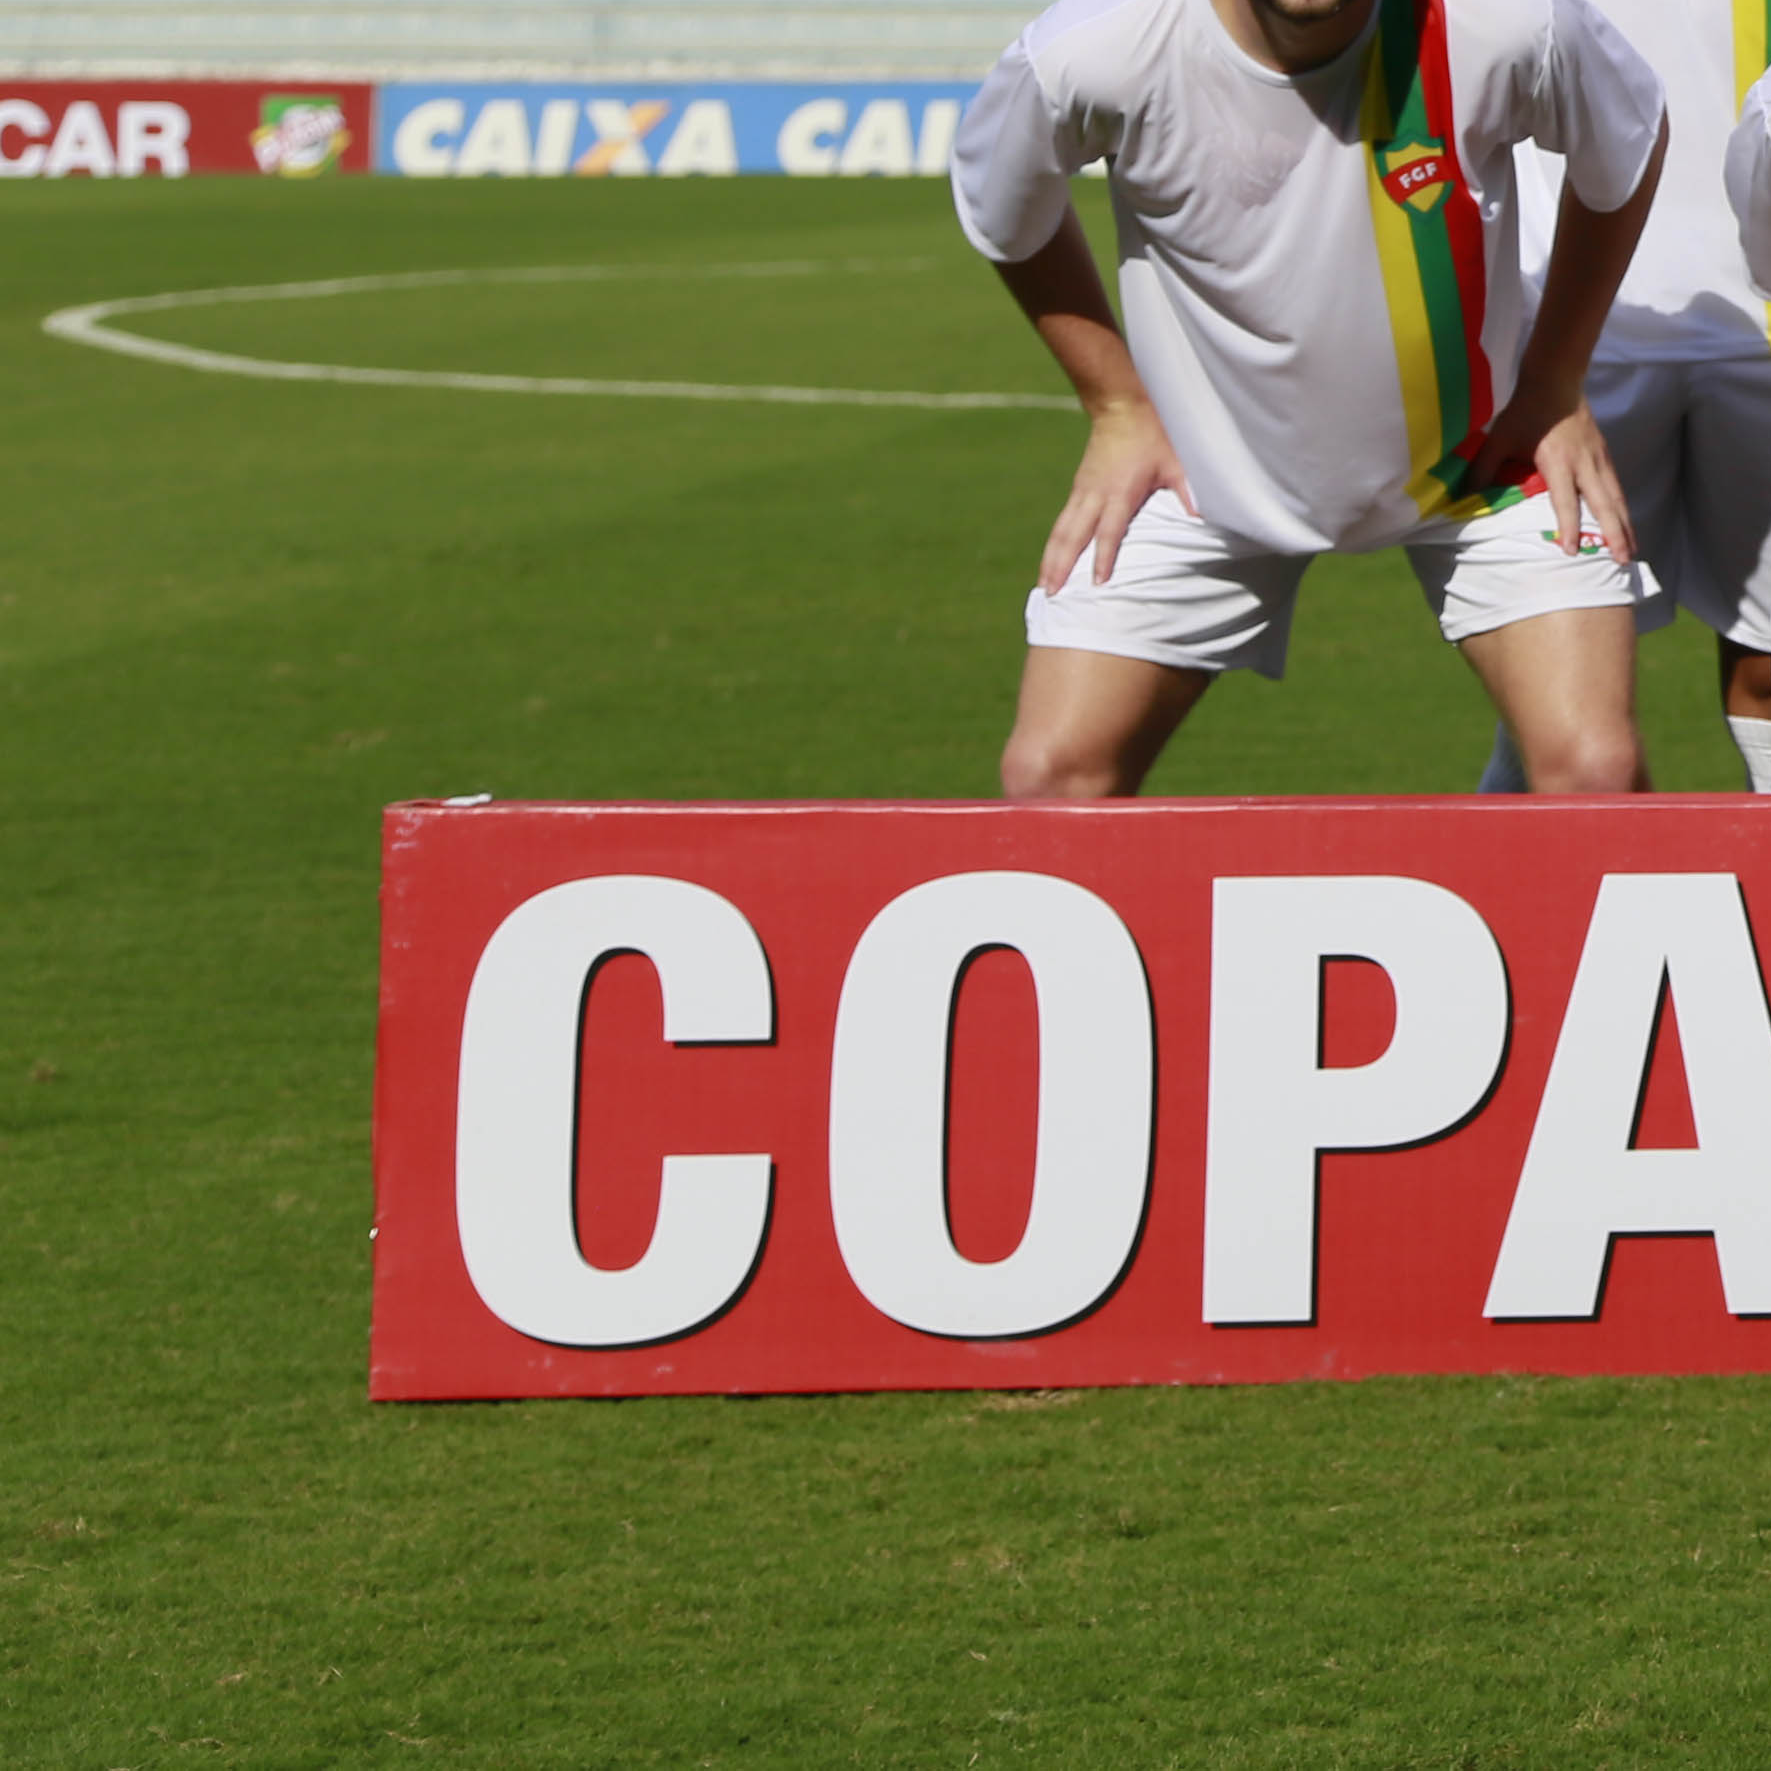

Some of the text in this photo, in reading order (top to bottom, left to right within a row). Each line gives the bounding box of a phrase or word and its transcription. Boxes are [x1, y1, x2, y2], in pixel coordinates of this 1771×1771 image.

[0, 98, 191, 178] CAR
[392, 98, 739, 177] CAIXA
[1398, 161, 1438, 190] FGF
